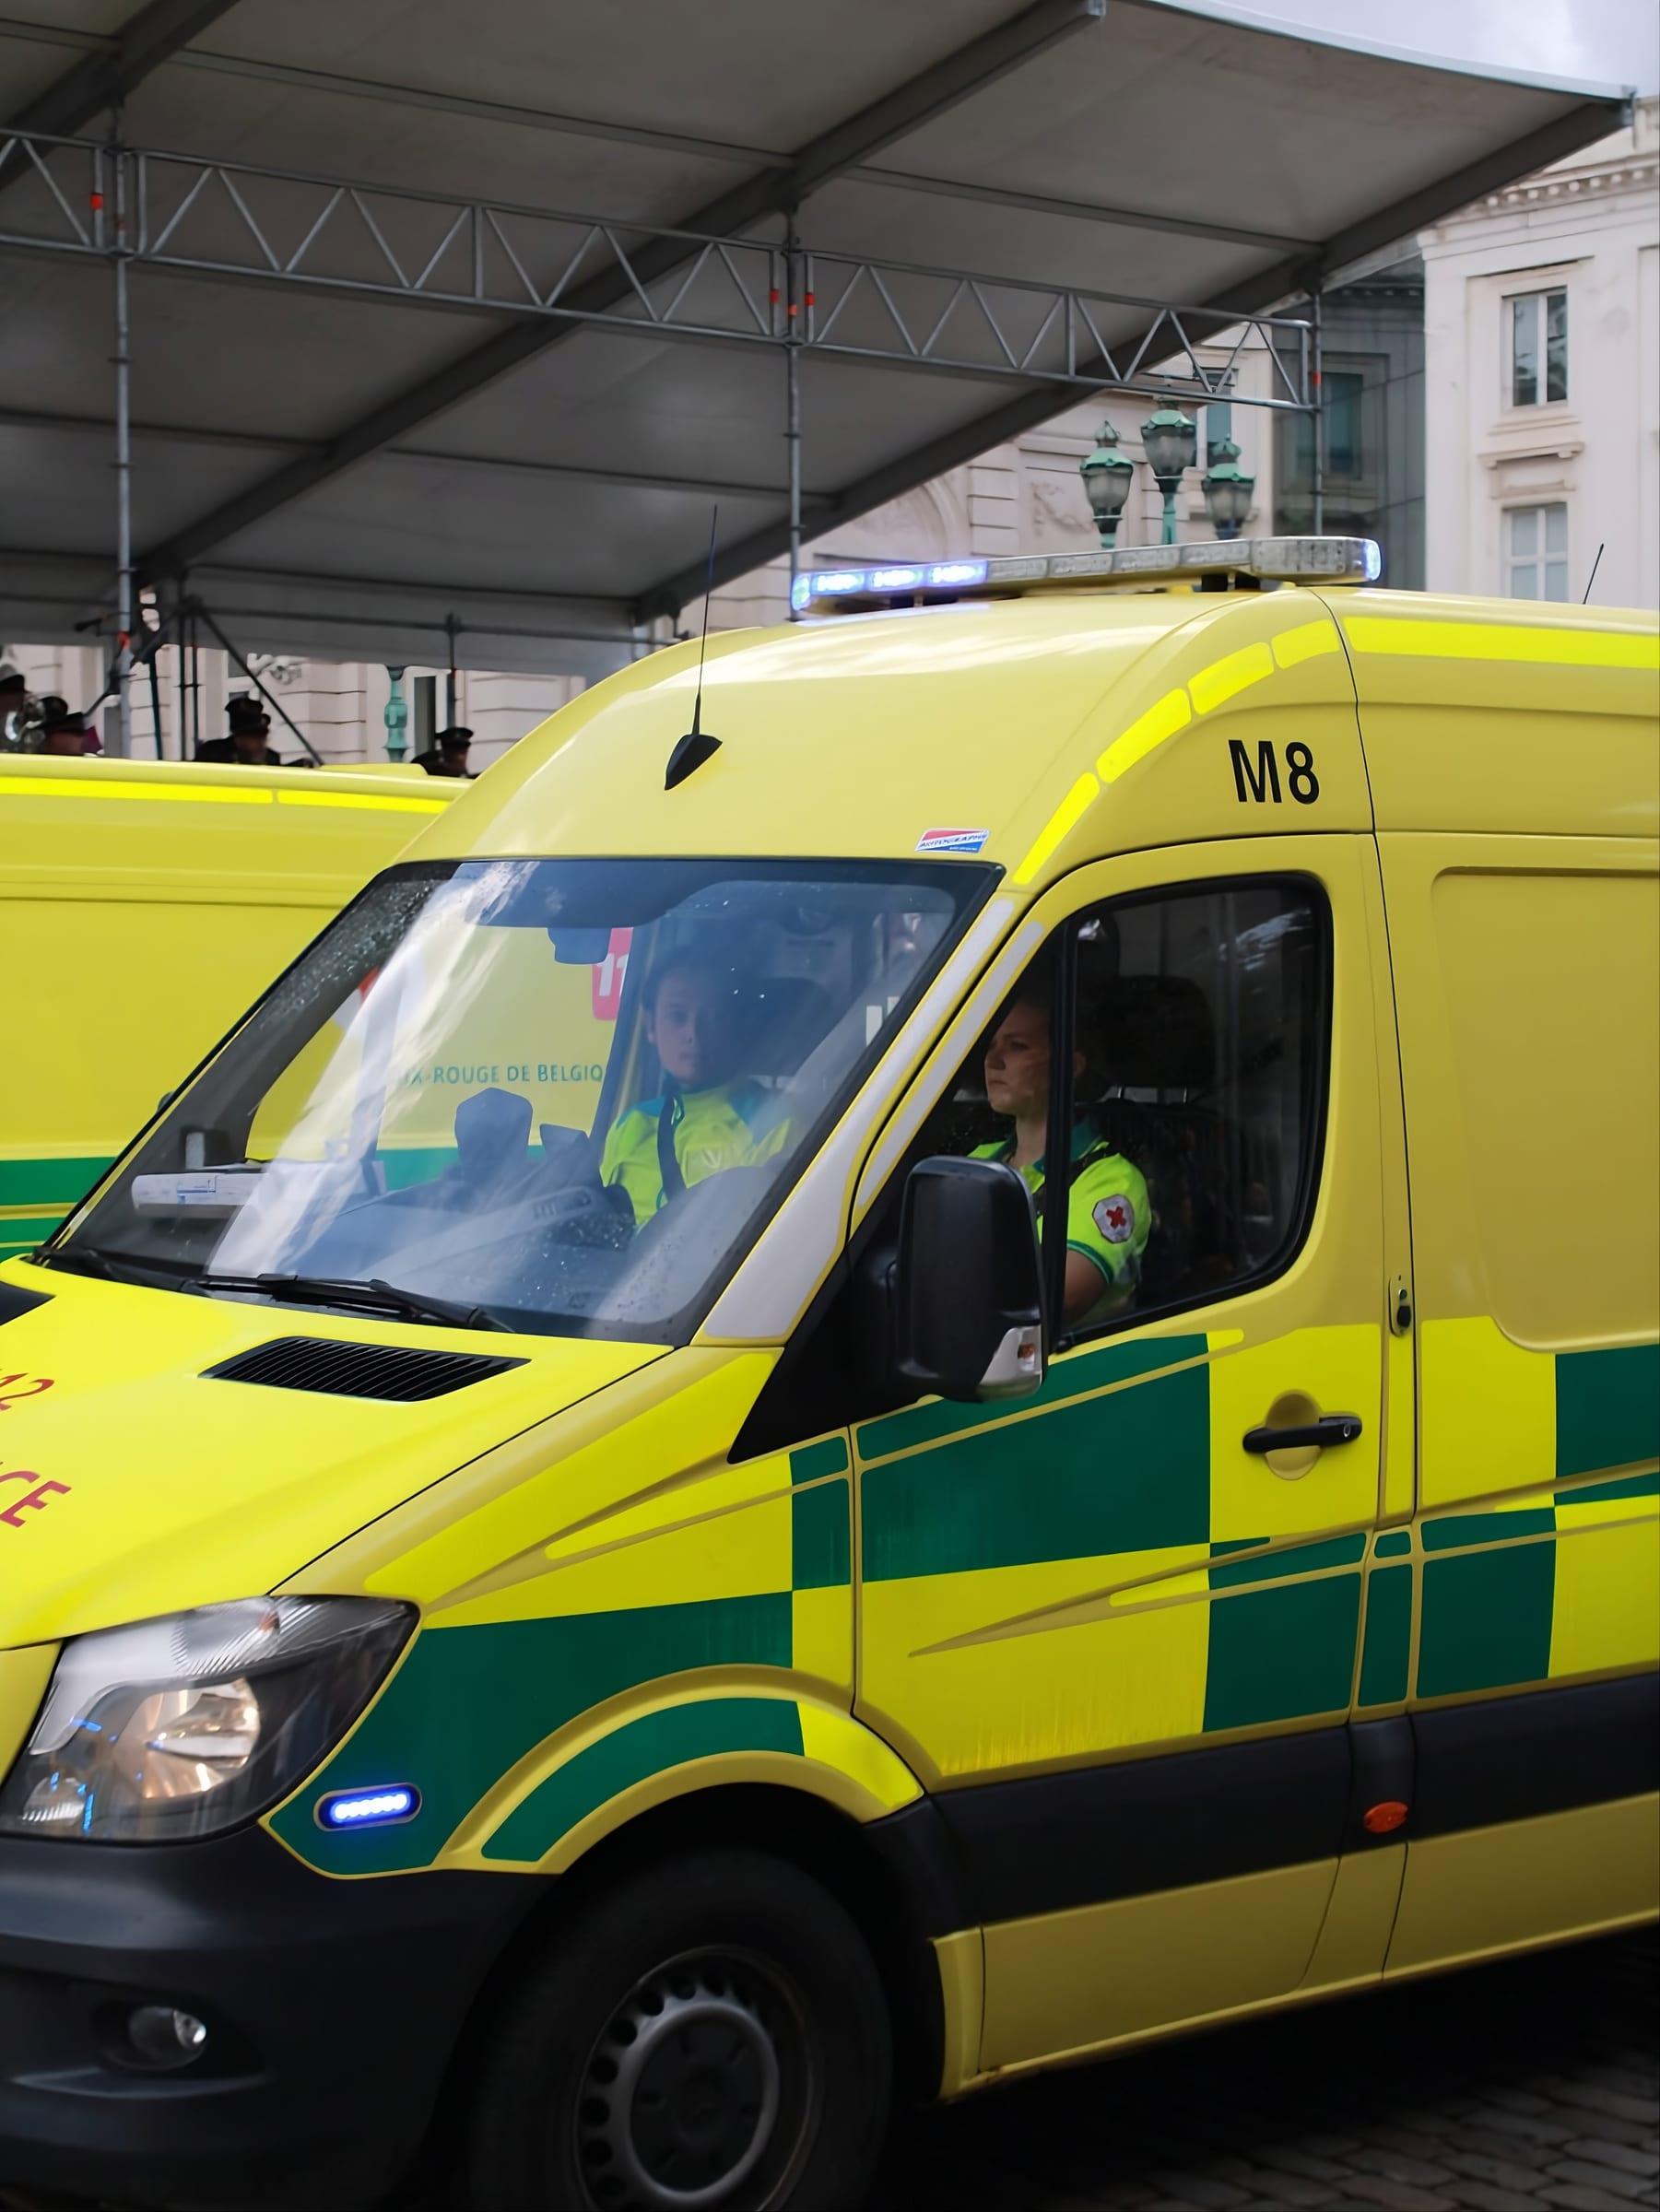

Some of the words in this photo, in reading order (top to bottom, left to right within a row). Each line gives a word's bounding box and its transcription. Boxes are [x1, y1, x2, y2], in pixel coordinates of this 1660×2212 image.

[1228, 739, 1320, 805] M8
[506, 1065, 530, 1083] DE
[537, 1064, 604, 1083] BELGIQ
